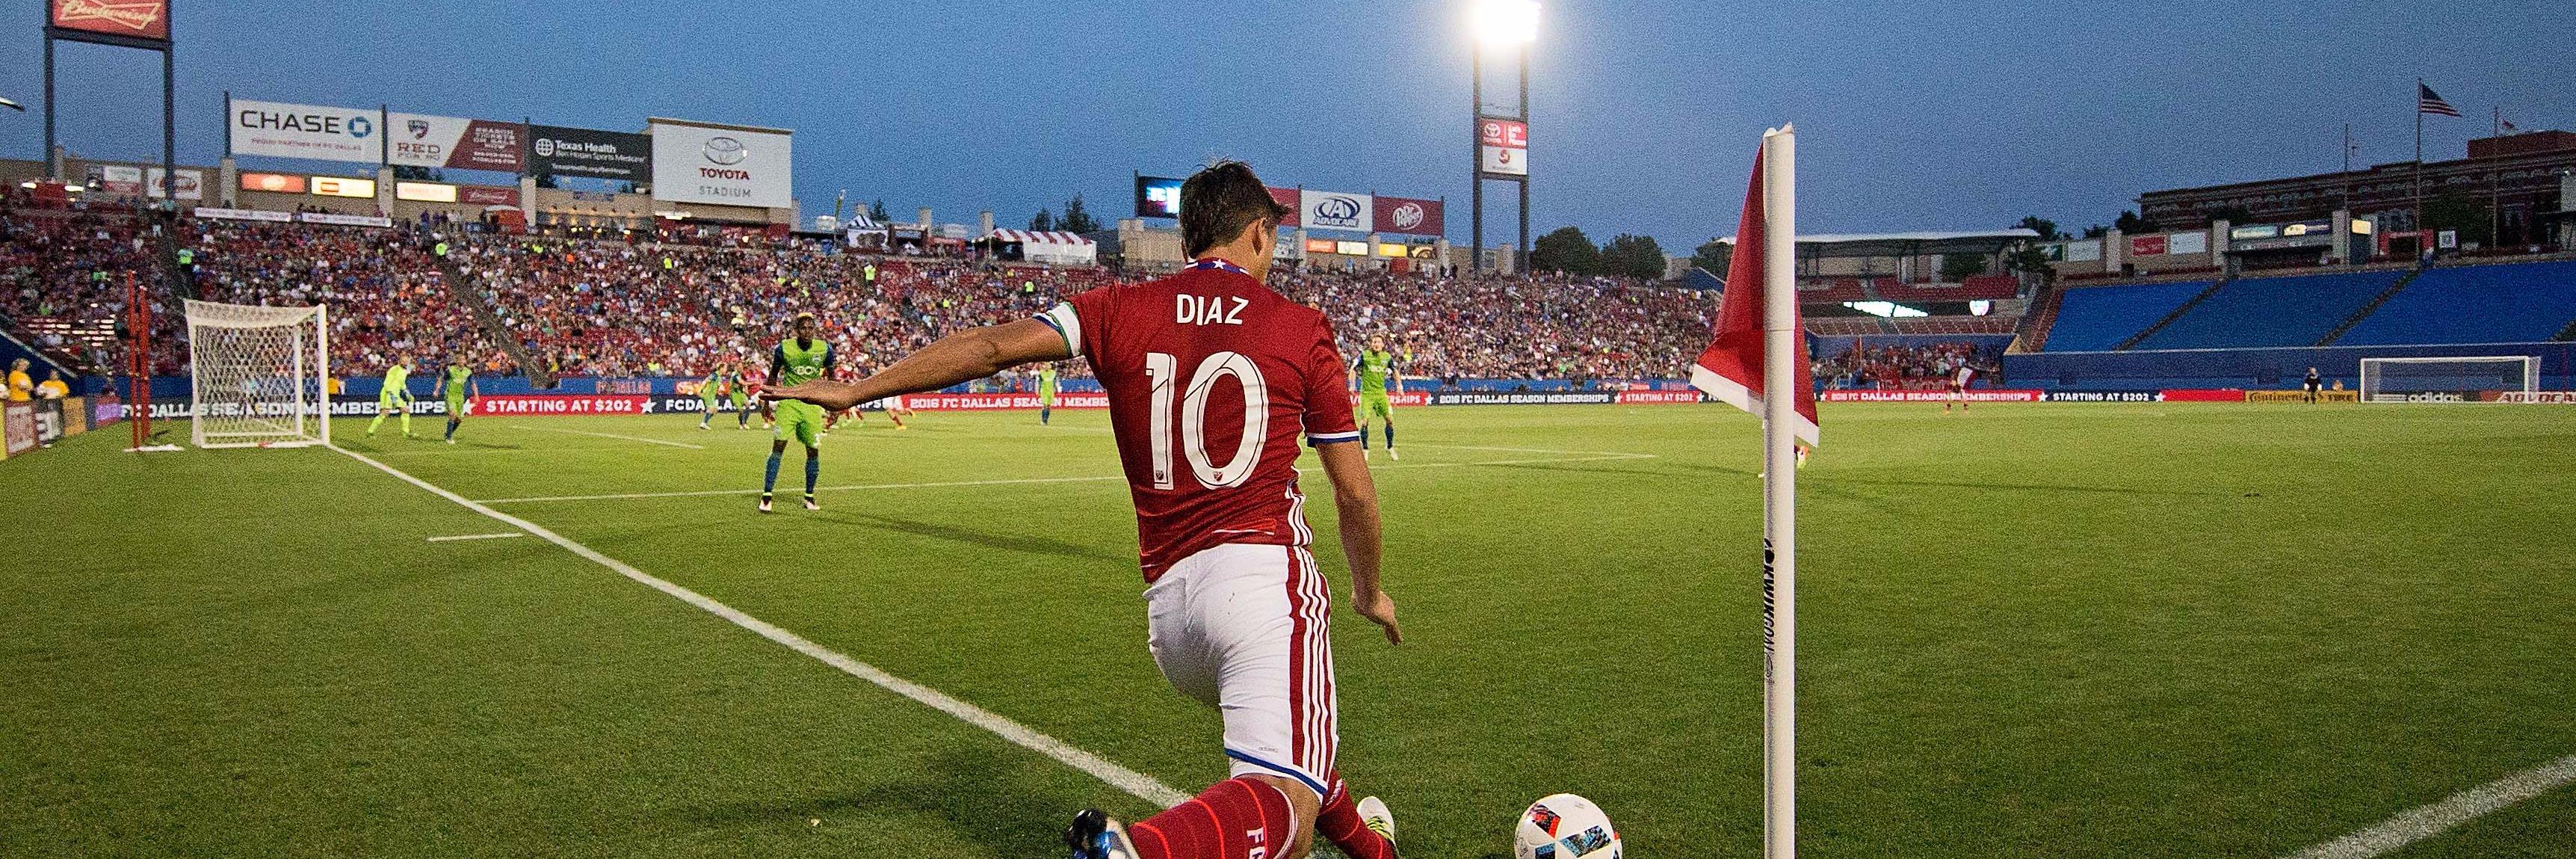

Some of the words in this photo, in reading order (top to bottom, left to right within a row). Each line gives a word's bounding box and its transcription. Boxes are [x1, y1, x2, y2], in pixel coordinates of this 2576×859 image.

[241, 110, 341, 134] CHASE
[398, 142, 441, 153] RED
[555, 140, 582, 151] Texas
[584, 142, 616, 154] Health
[699, 167, 750, 180] TOYOTA
[699, 185, 751, 197] STADIUM
[1176, 294, 1249, 325] DIAZ
[1439, 395, 1460, 403] 2016
[1462, 395, 1472, 403] FC
[1474, 395, 1509, 403] DALLAS
[1510, 394, 1545, 403] SEASON
[1547, 394, 1608, 402] MEMBERSHIPS
[1625, 393, 1663, 401] STARTING
[1664, 393, 1674, 401] AT
[1675, 393, 1693, 401] $202
[1861, 392, 1904, 401] DALLAS
[1906, 392, 1949, 401] SEASON
[2053, 392, 2103, 401] STARTING
[2106, 392, 2119, 401] AT
[2122, 392, 2149, 401] $202
[2408, 392, 2464, 403] adidas
[487, 400, 566, 412] STARTING
[571, 400, 591, 411] AT
[595, 398, 633, 412] $202
[909, 398, 939, 409] 2016
[942, 398, 959, 409] FC
[962, 397, 1010, 408] DALLAS
[1013, 397, 1062, 407] SEASN
[1146, 351, 1269, 490] 10
